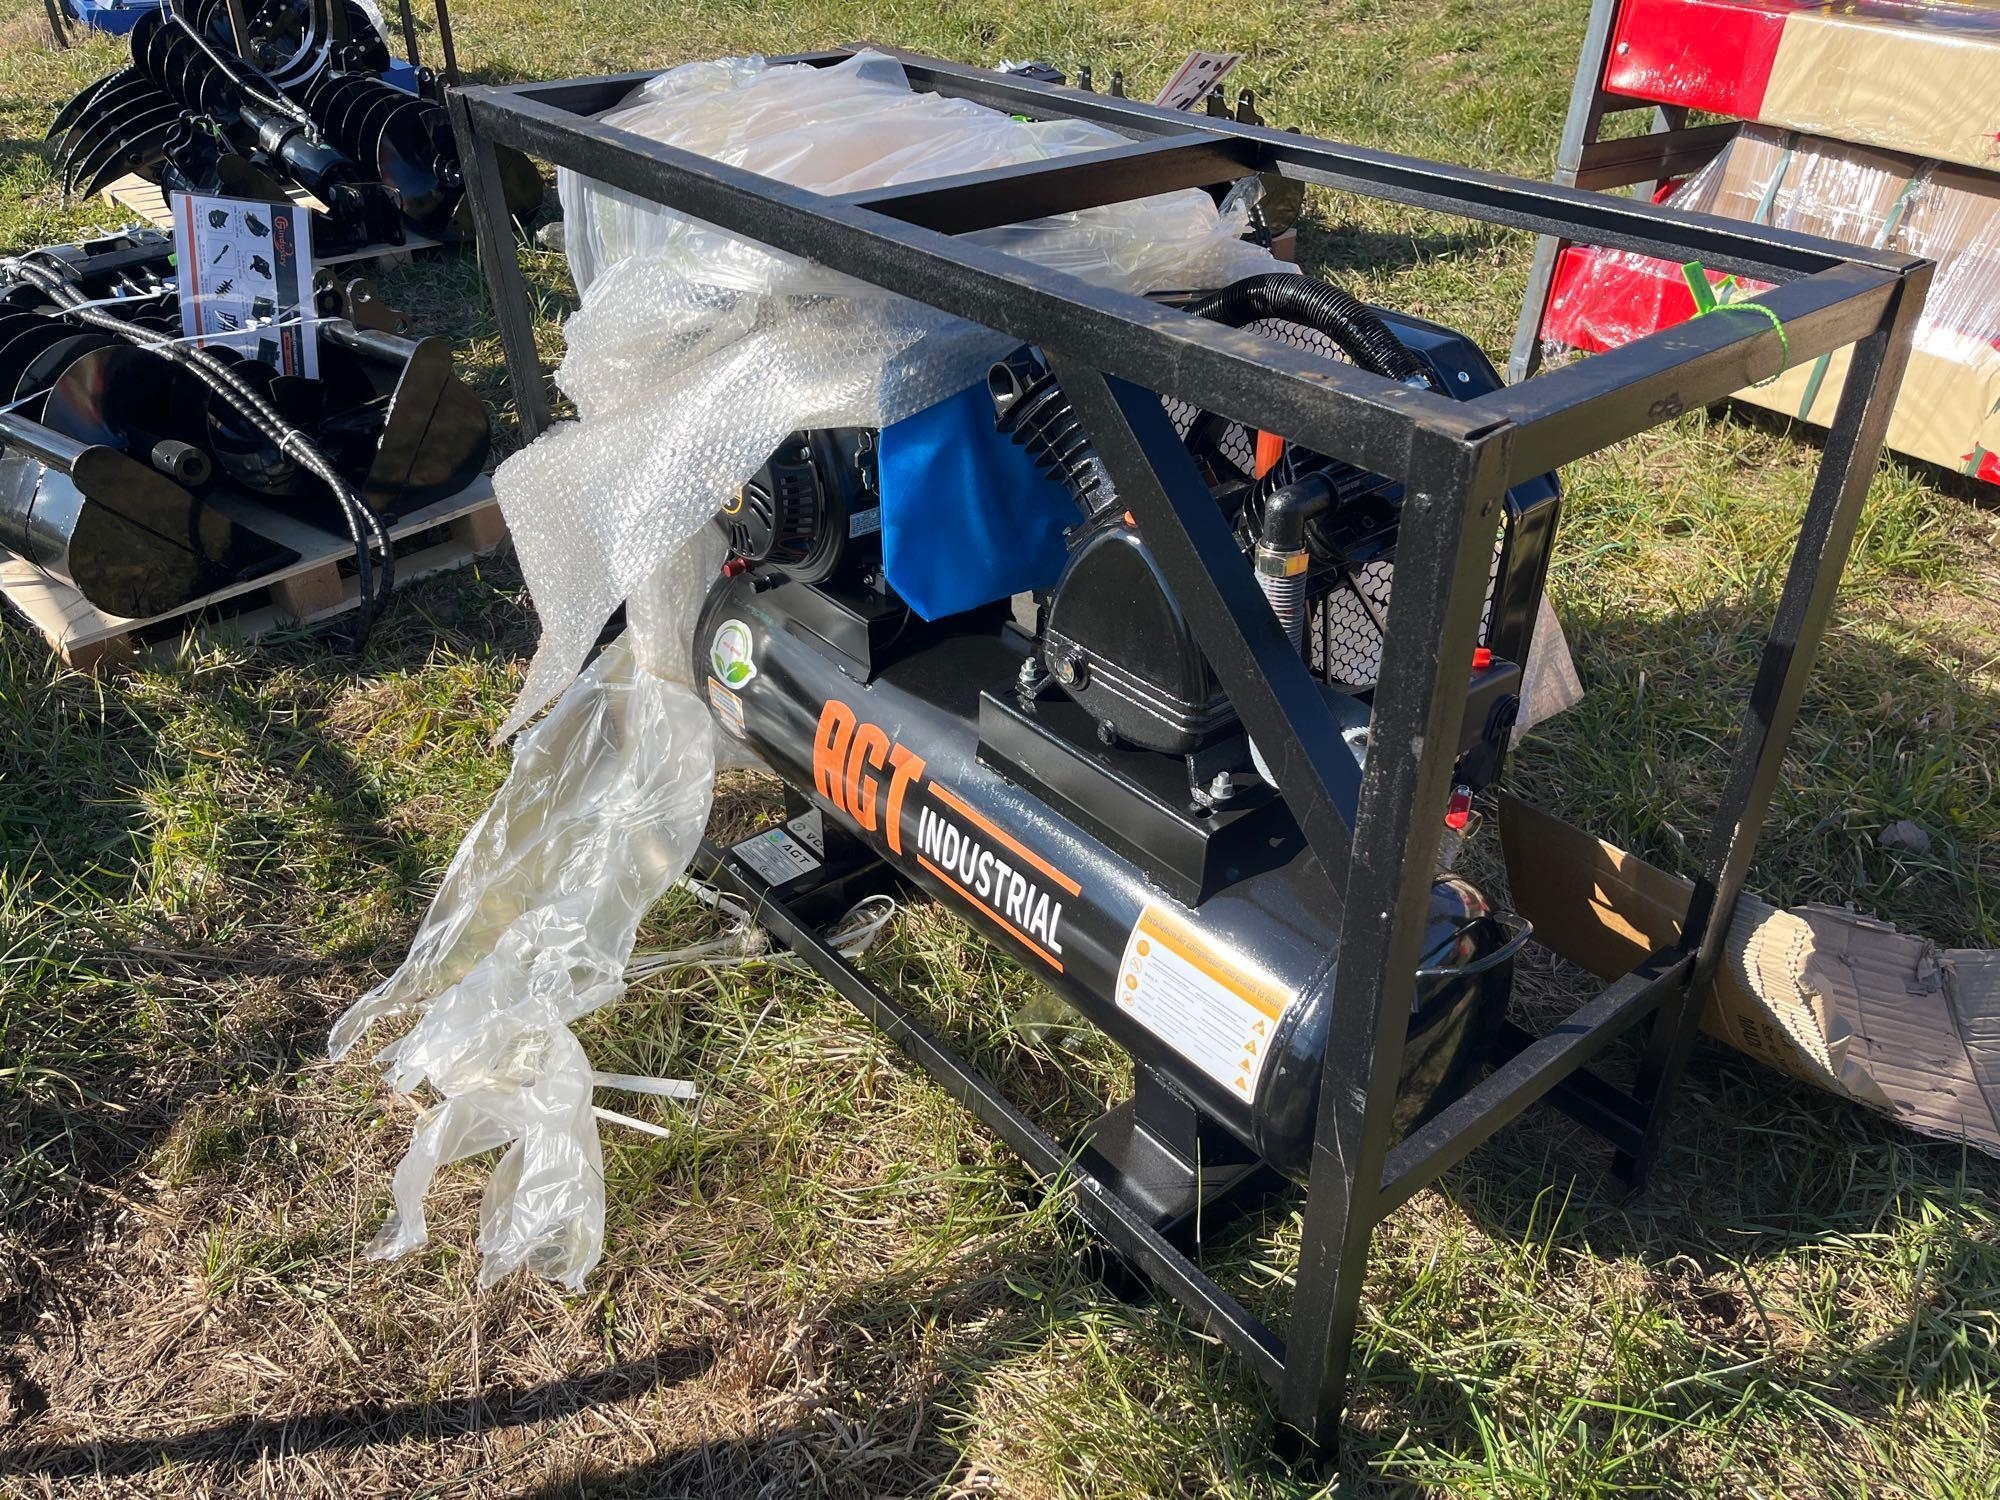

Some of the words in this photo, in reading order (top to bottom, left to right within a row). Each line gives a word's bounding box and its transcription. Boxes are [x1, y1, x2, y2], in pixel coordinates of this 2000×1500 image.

[782, 844, 811, 864] AGT
[917, 805, 1064, 955] INDUSTRIAL
[1186, 942, 1224, 969] compressor
[1234, 975, 1257, 993] points
[1256, 988, 1266, 999] to
